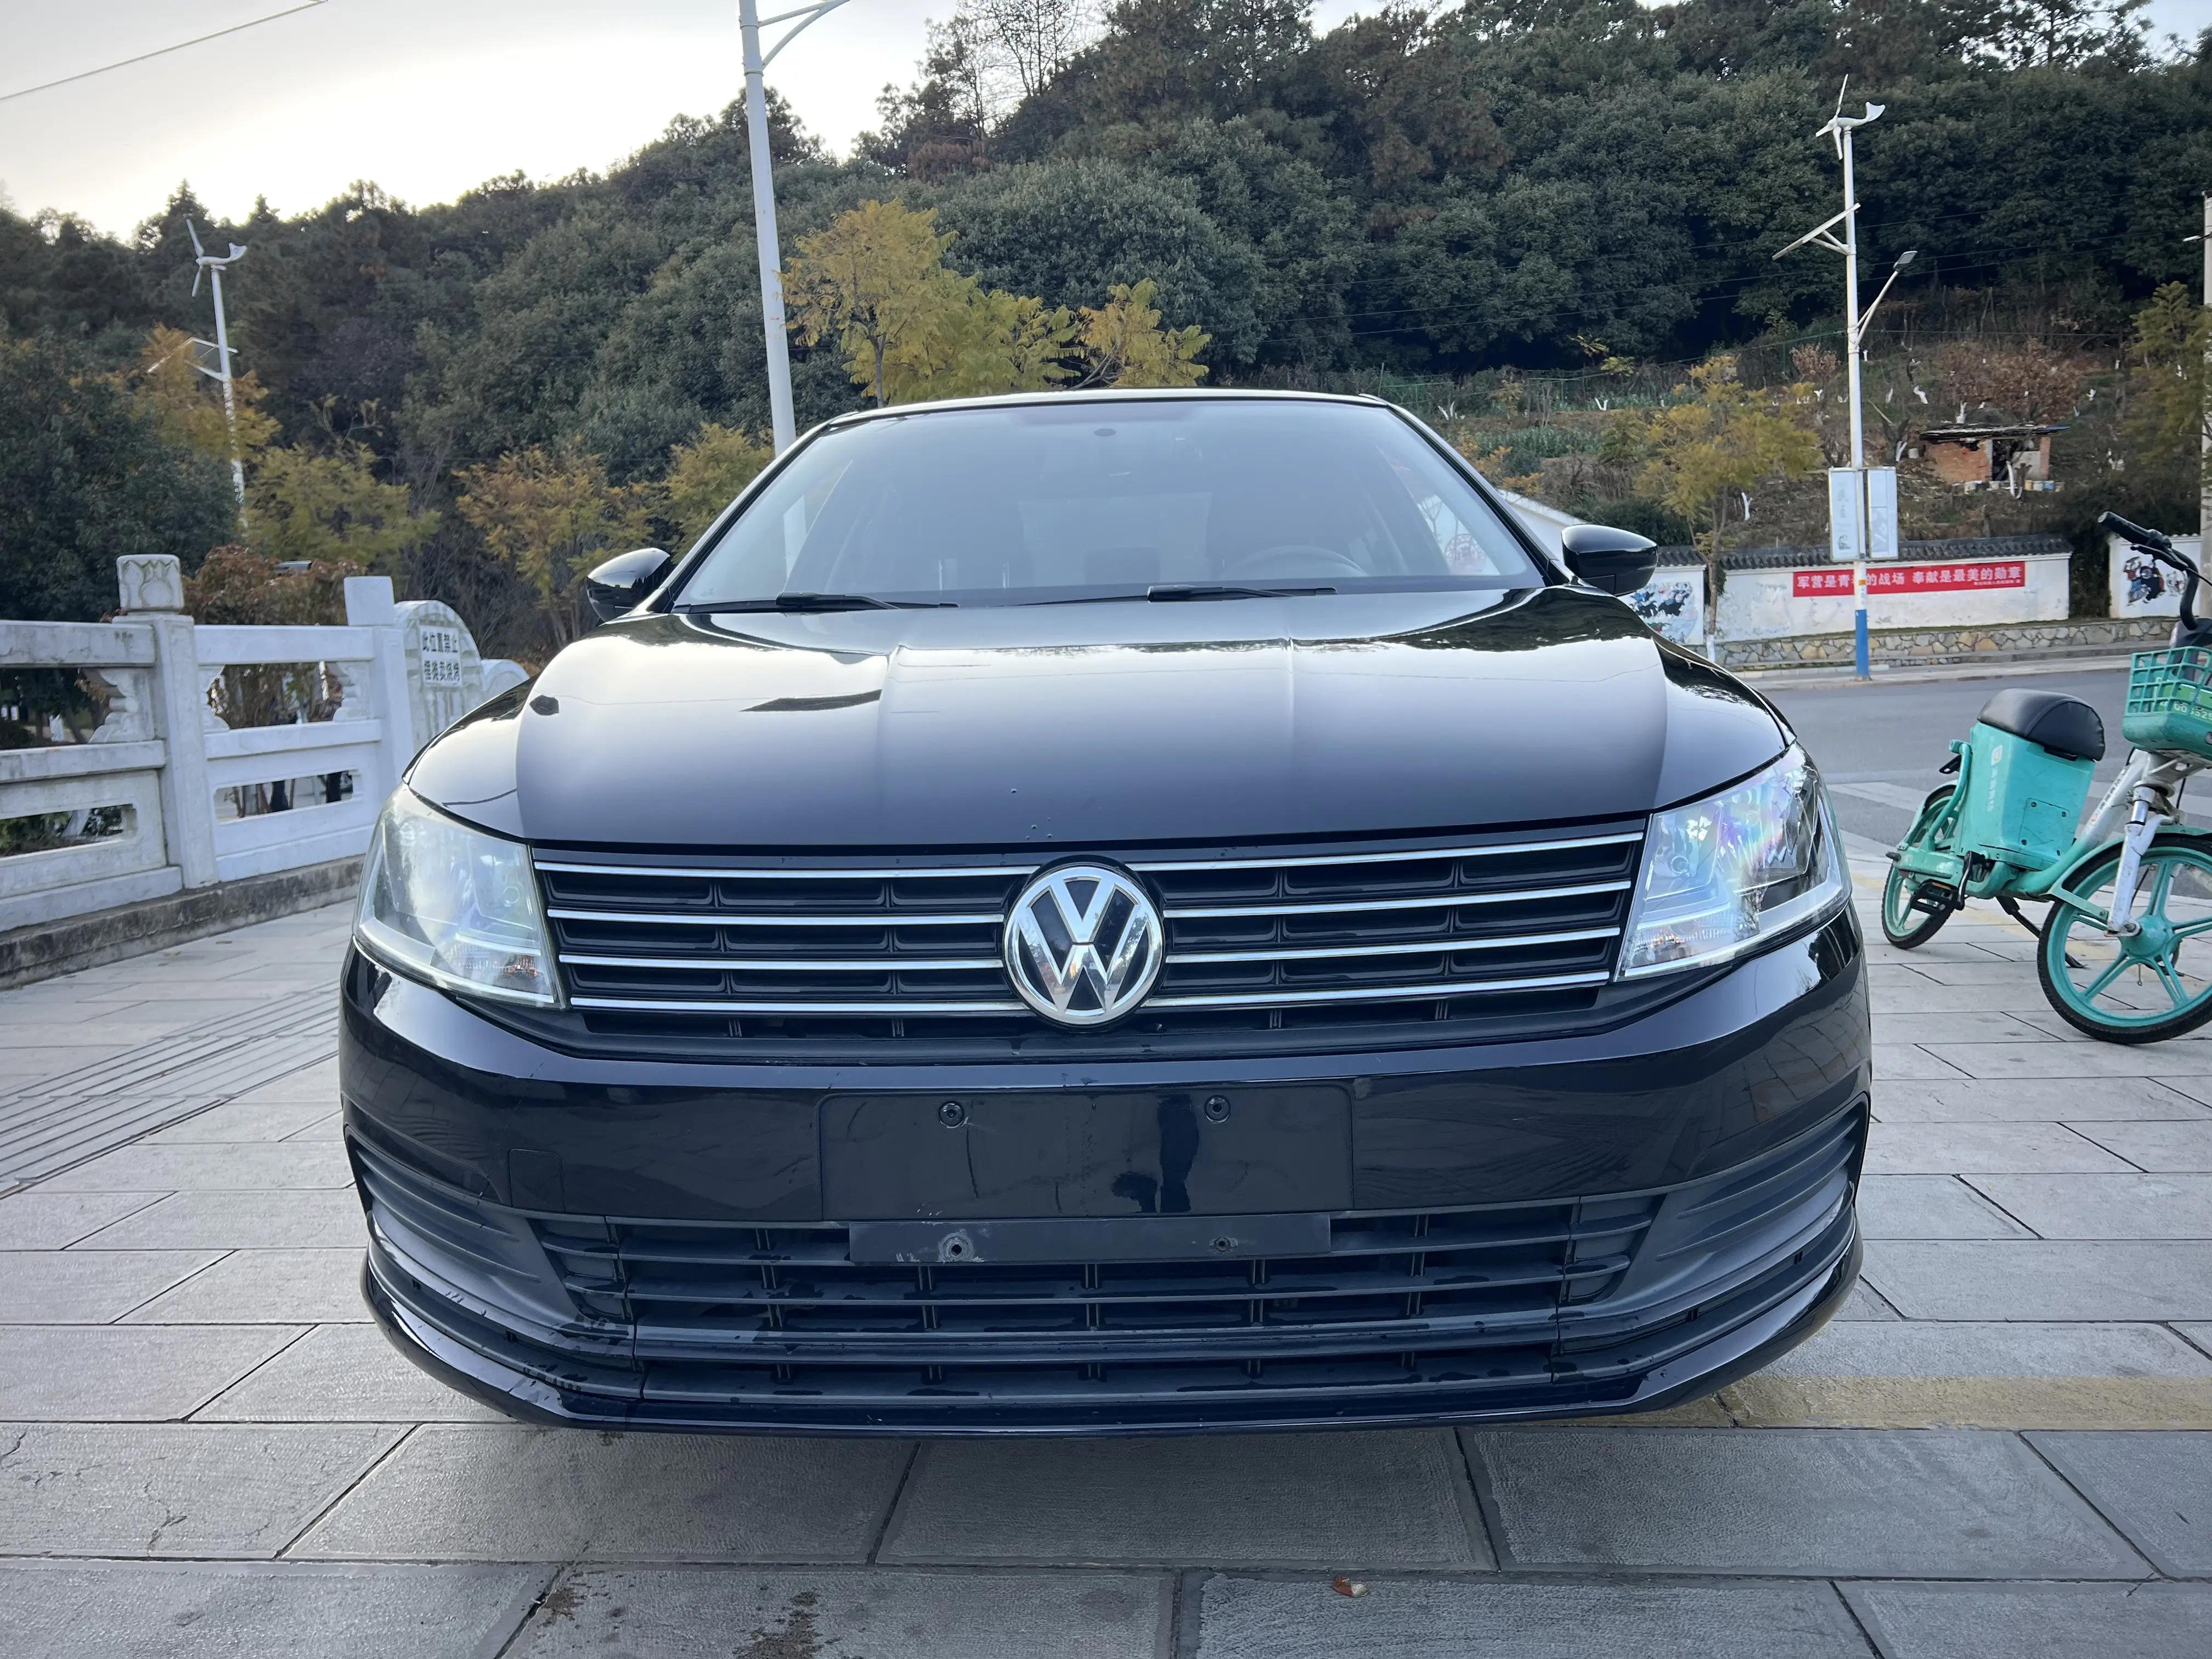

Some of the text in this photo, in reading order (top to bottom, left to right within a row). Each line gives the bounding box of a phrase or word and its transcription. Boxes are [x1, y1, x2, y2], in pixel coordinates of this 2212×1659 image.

[1797, 566, 2022, 589] 军营是青的战场 奉献是最美的勋章
[422, 631, 458, 653] 此位置禁止
[1008, 869, 1159, 1020] VW
